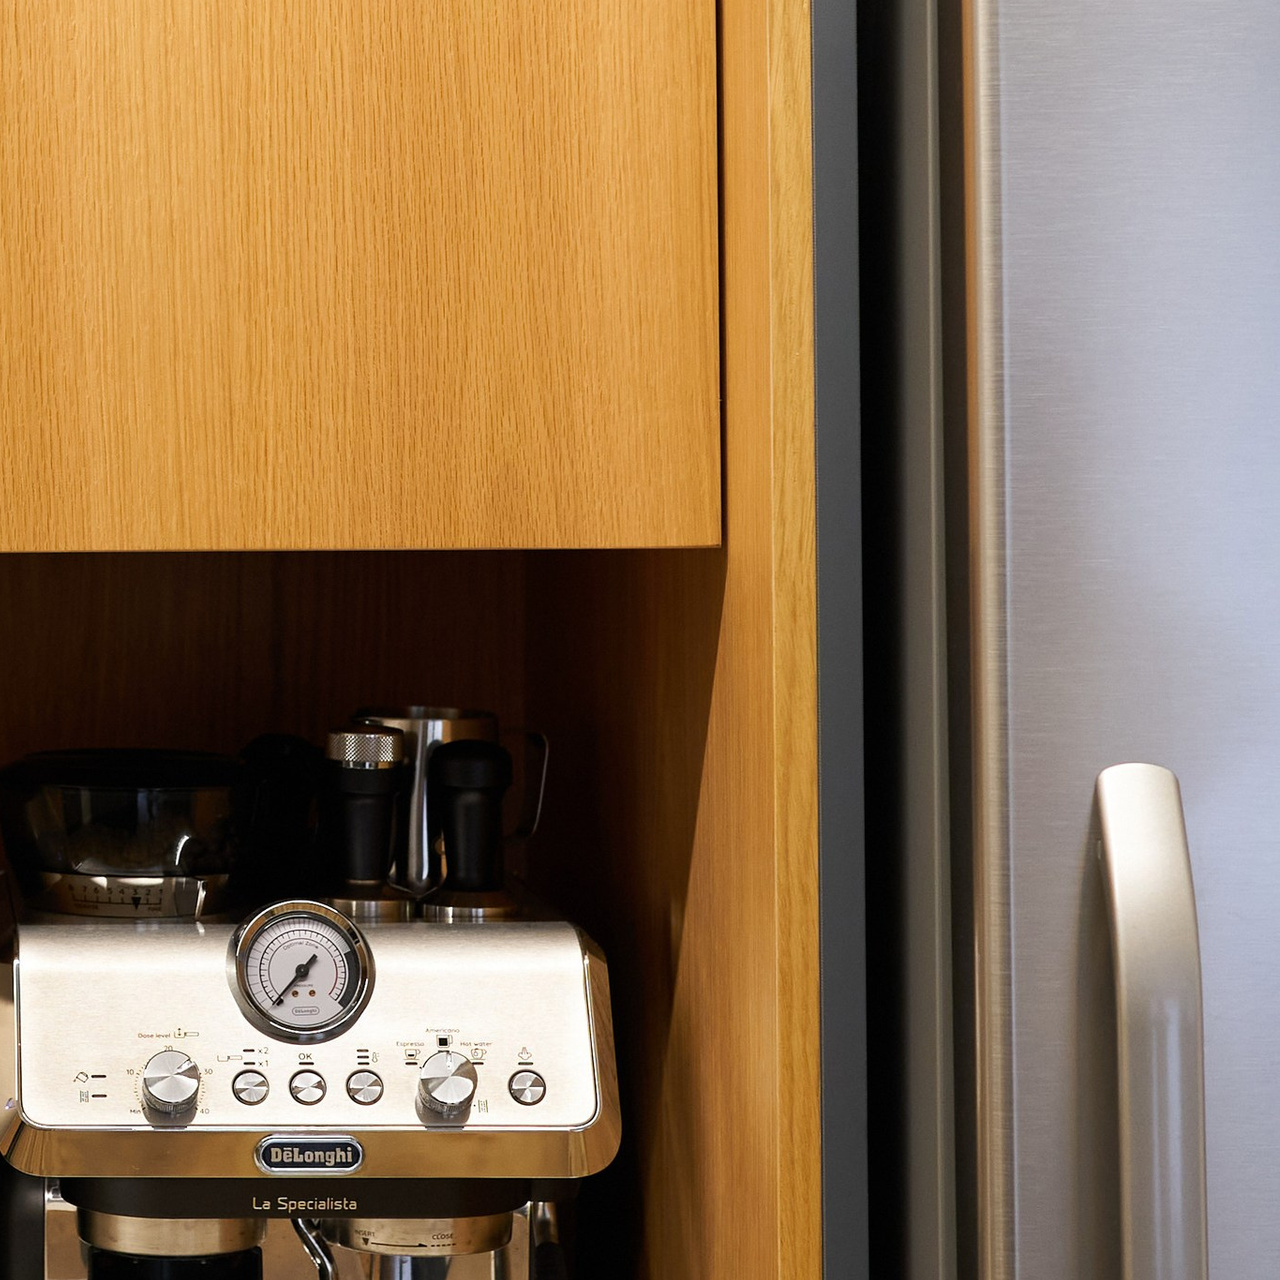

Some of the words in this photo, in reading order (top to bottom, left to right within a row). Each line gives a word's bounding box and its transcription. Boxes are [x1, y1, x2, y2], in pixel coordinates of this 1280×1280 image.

[283, 941, 304, 951] Optimal
[305, 941, 319, 949] Zone
[252, 1196, 271, 1210] La
[277, 1196, 358, 1213] Specialista
[354, 1229, 376, 1237] INSERT
[431, 1232, 455, 1241] CLOSE
